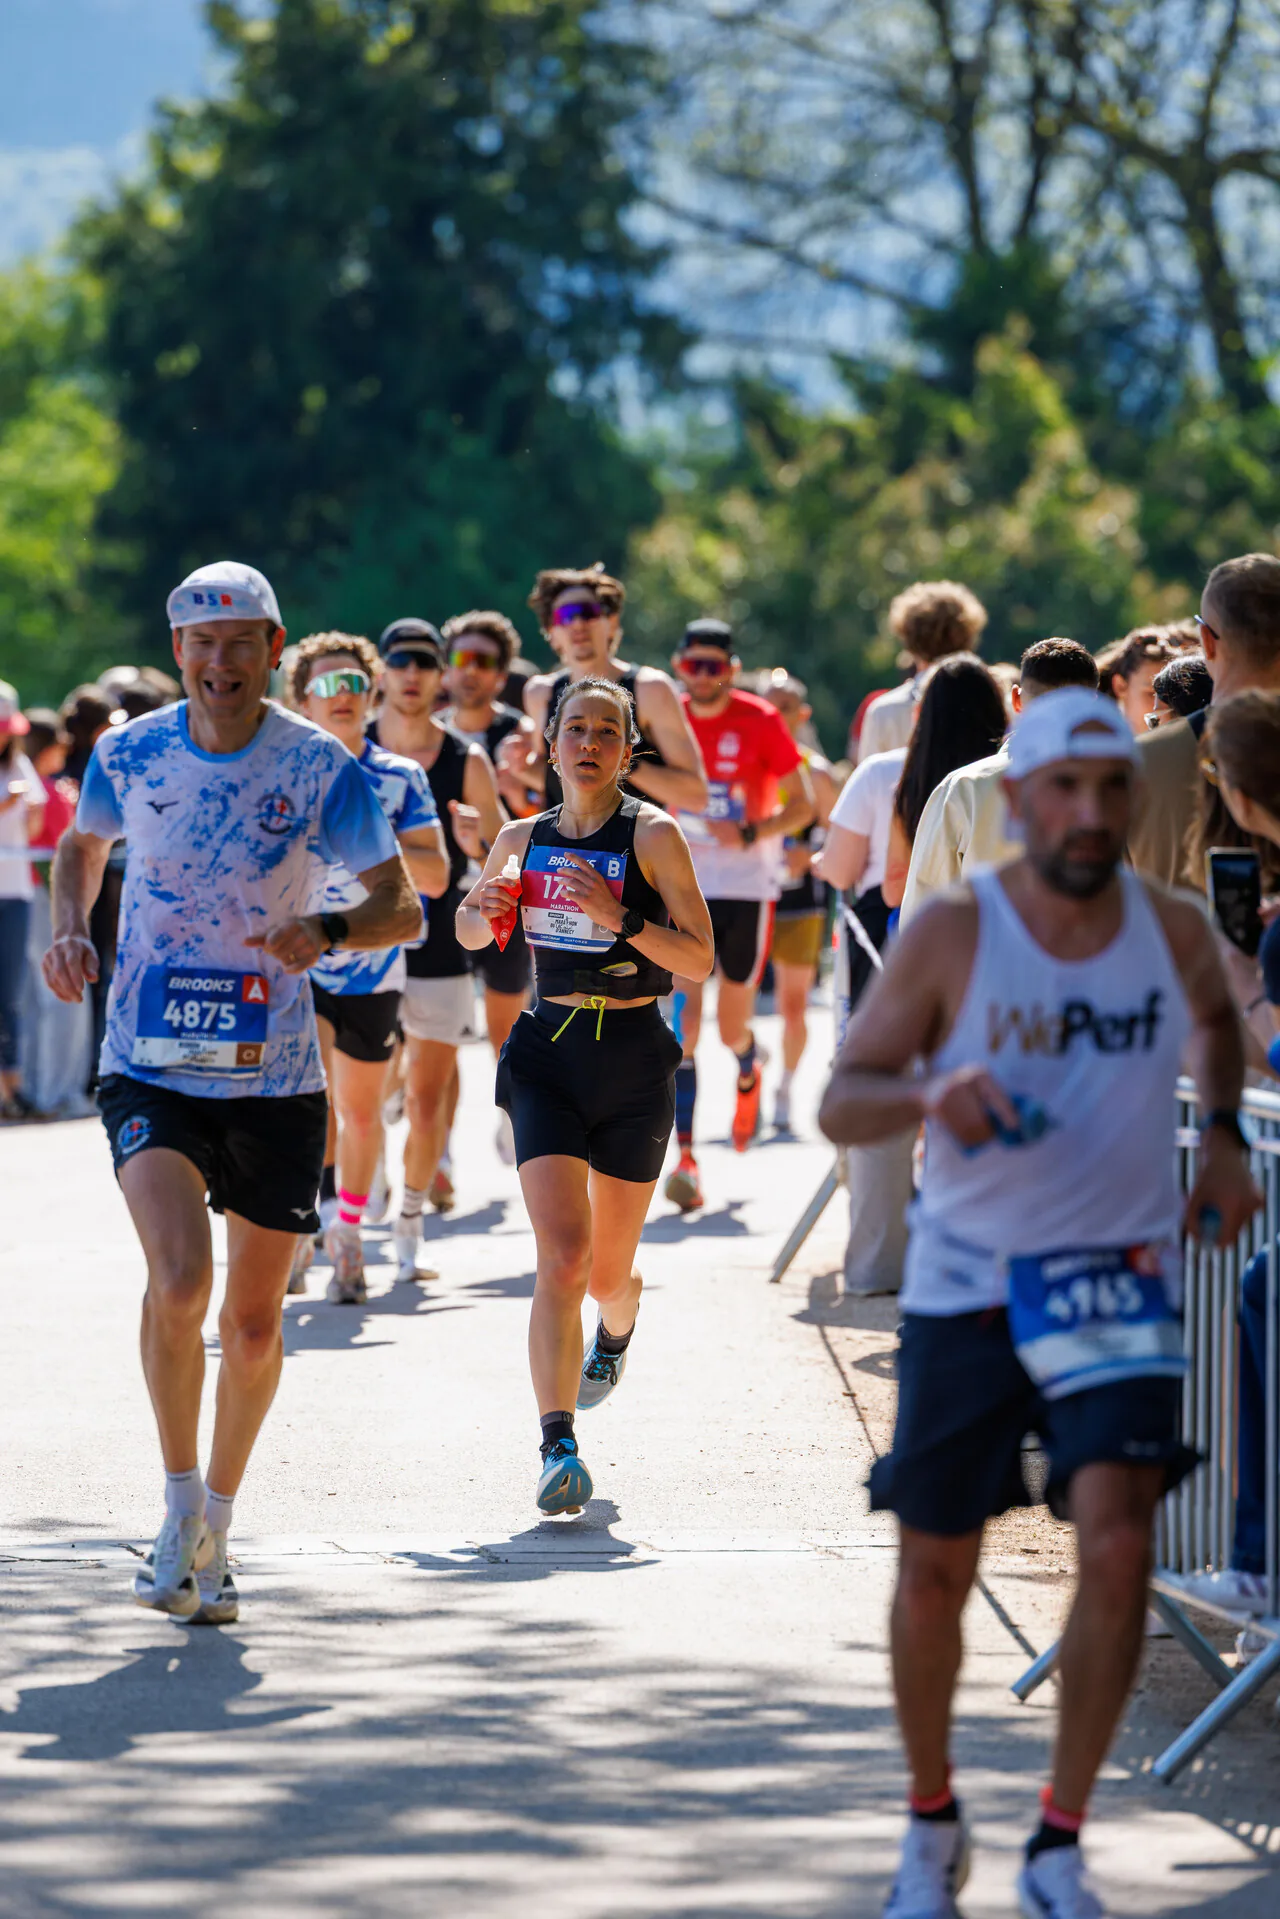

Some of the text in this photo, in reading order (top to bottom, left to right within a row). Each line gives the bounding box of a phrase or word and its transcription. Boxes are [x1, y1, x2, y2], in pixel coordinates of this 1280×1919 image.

[193, 592, 233, 607] BSR
[547, 856, 596, 868] BROS
[607, 860, 620, 878] B
[550, 903, 579, 912] MARATHON
[168, 977, 235, 993] BROOKS
[247, 979, 264, 1001] A
[162, 999, 237, 1030] 4875
[987, 988, 1164, 1057] WePerf
